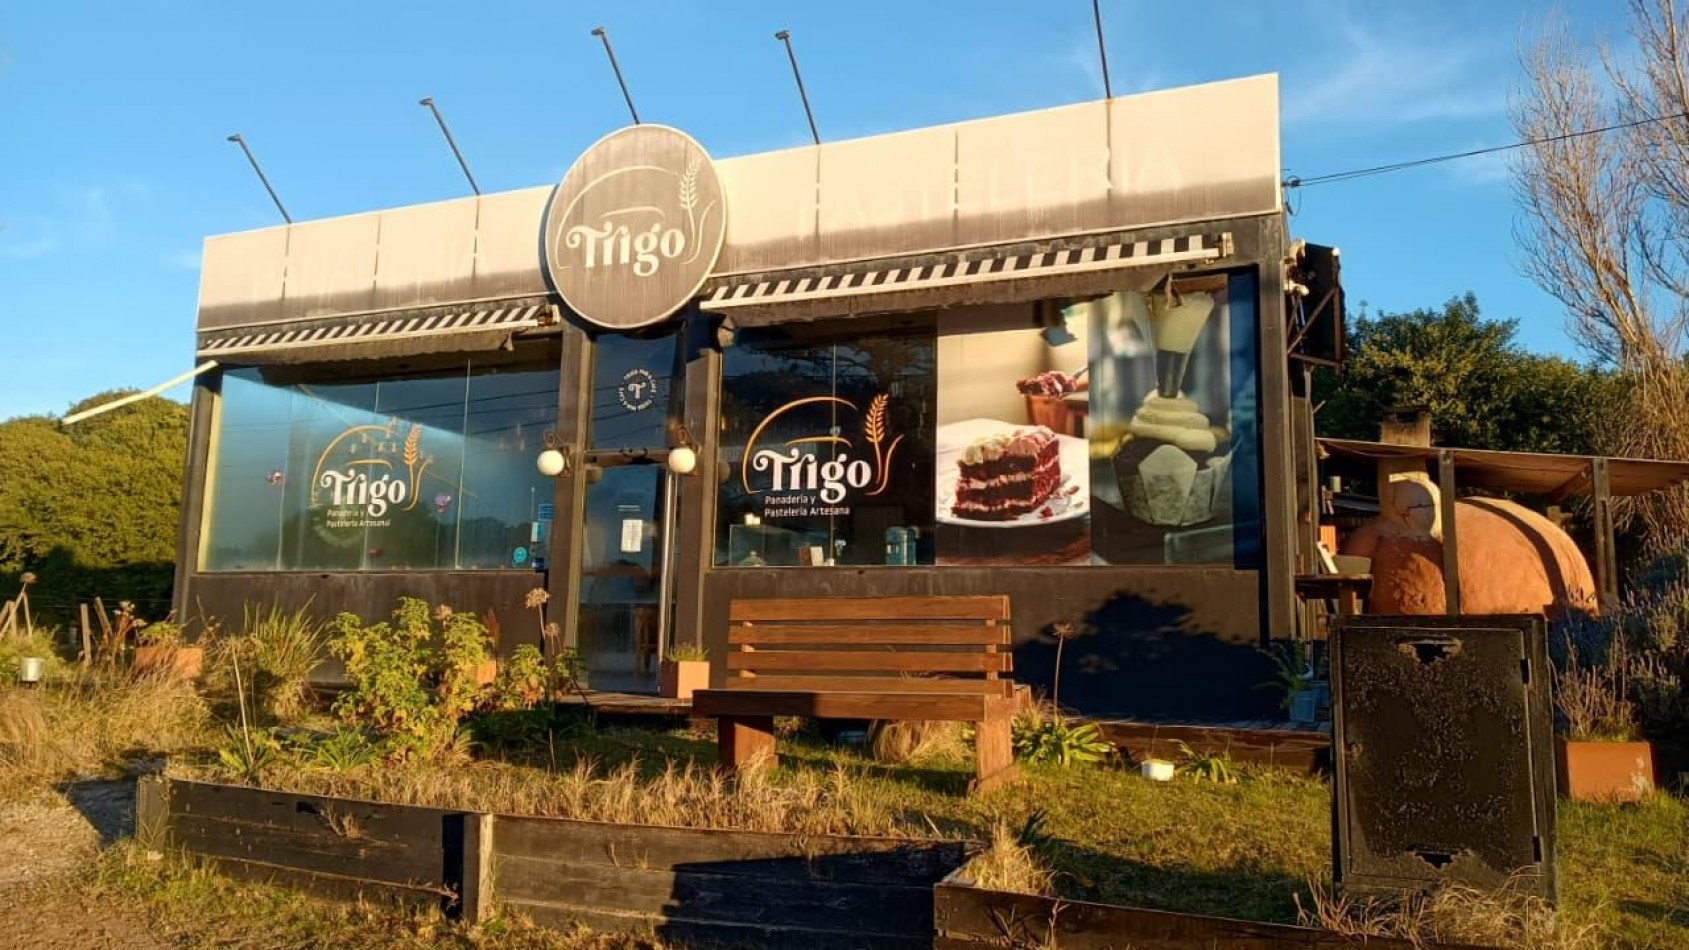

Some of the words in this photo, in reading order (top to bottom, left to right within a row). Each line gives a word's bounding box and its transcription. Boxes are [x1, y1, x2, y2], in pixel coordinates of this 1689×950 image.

[565, 221, 686, 277] Trigo
[320, 468, 406, 517] Trigo
[752, 447, 872, 504] Trigo
[810, 495, 816, 505] y
